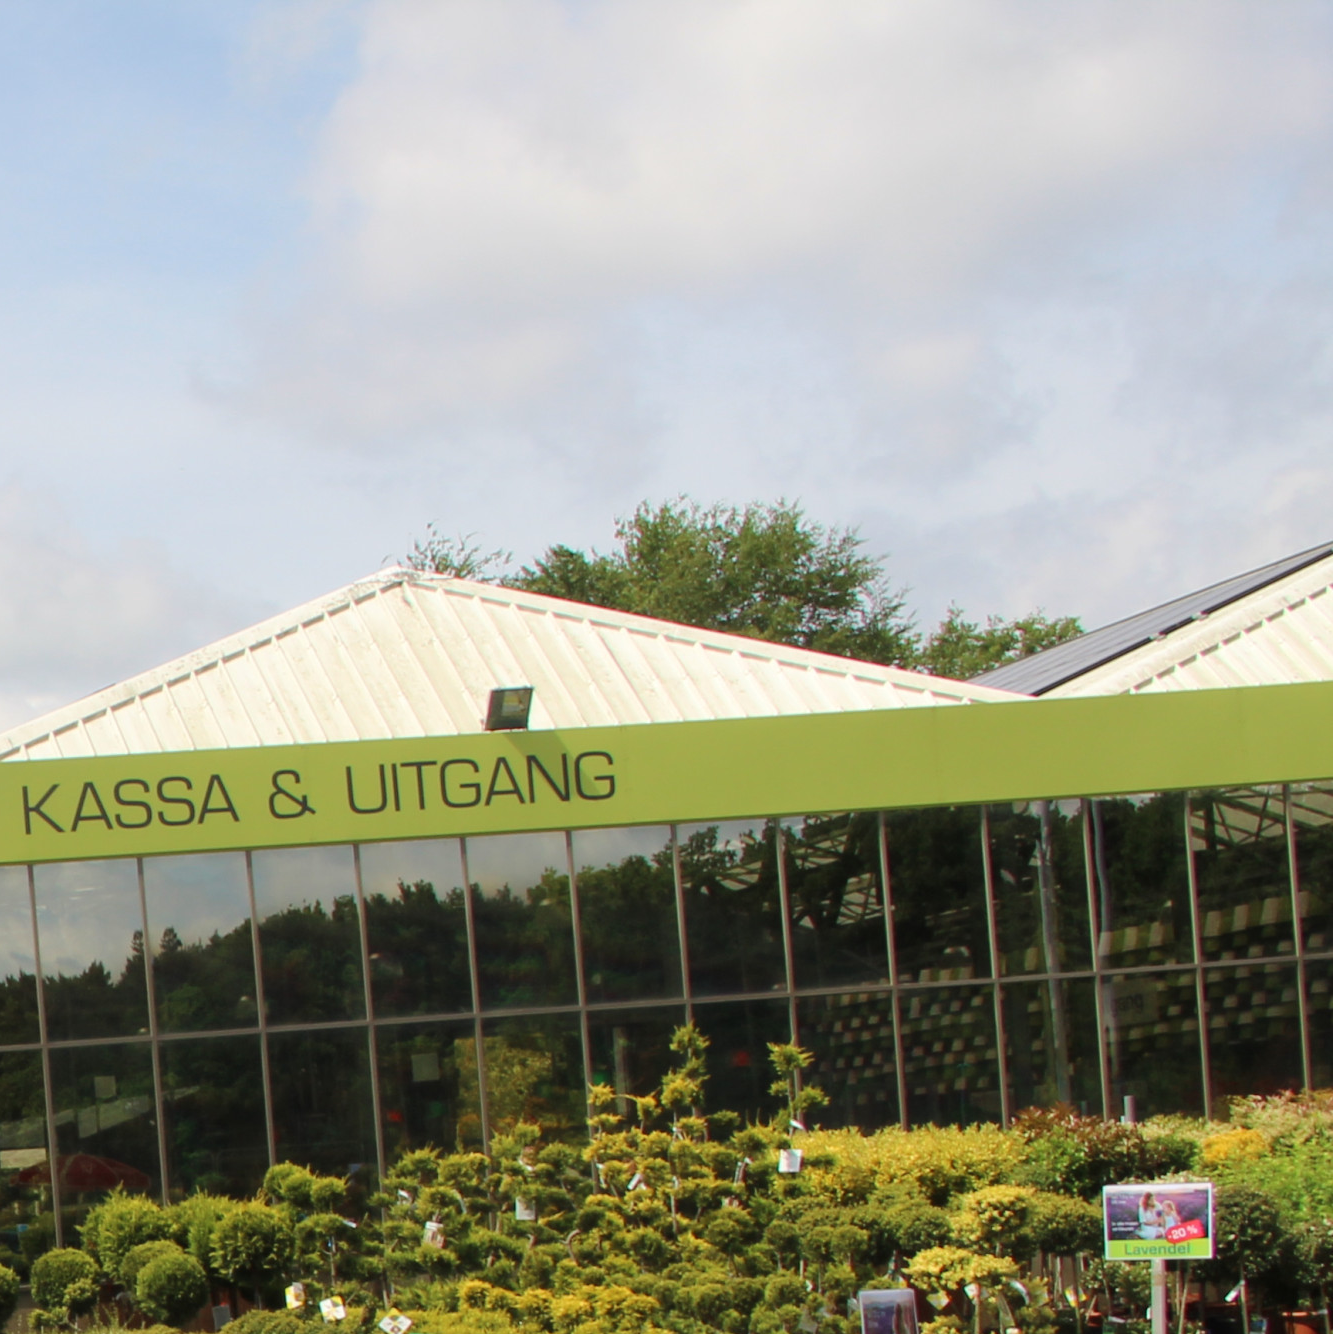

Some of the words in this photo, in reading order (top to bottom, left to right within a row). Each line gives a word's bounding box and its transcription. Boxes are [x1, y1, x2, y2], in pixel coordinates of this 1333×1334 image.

[23, 775, 240, 836] KASSA
[267, 769, 315, 820] &
[345, 750, 616, 815] UITGANG
[1124, 1242, 1191, 1256] Lavendel
